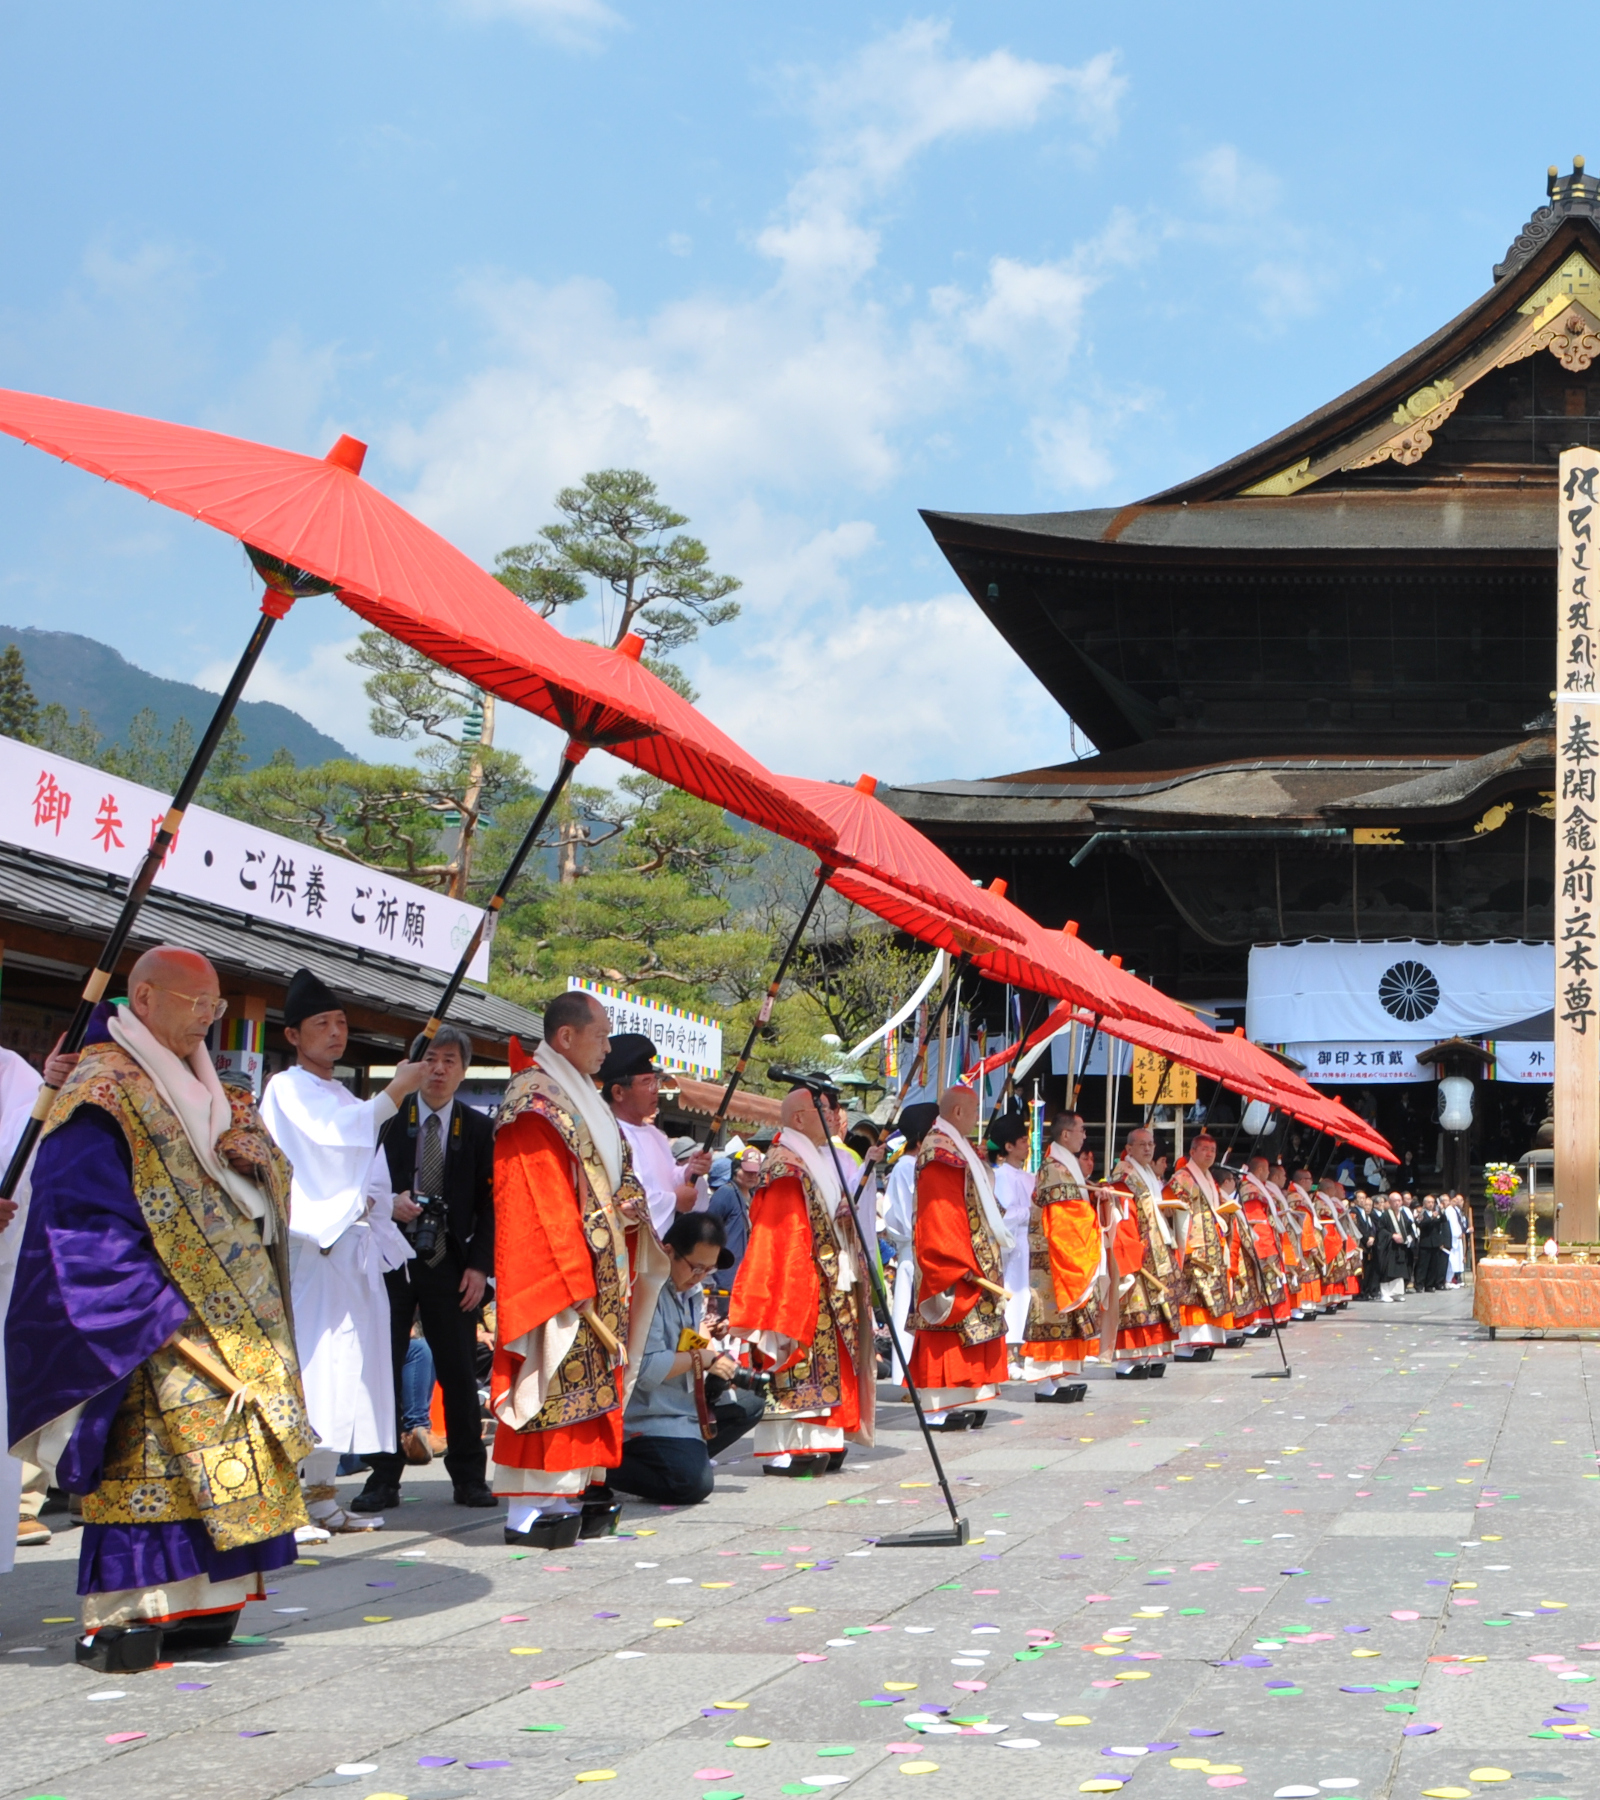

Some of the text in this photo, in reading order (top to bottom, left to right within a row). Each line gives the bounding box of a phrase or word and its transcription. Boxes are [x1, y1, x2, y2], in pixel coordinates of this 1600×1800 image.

[351, 886, 426, 949] ご祈願
[1136, 1056, 1148, 1099] 善光寺
[1317, 1050, 1404, 1066] 御印文頂戴
